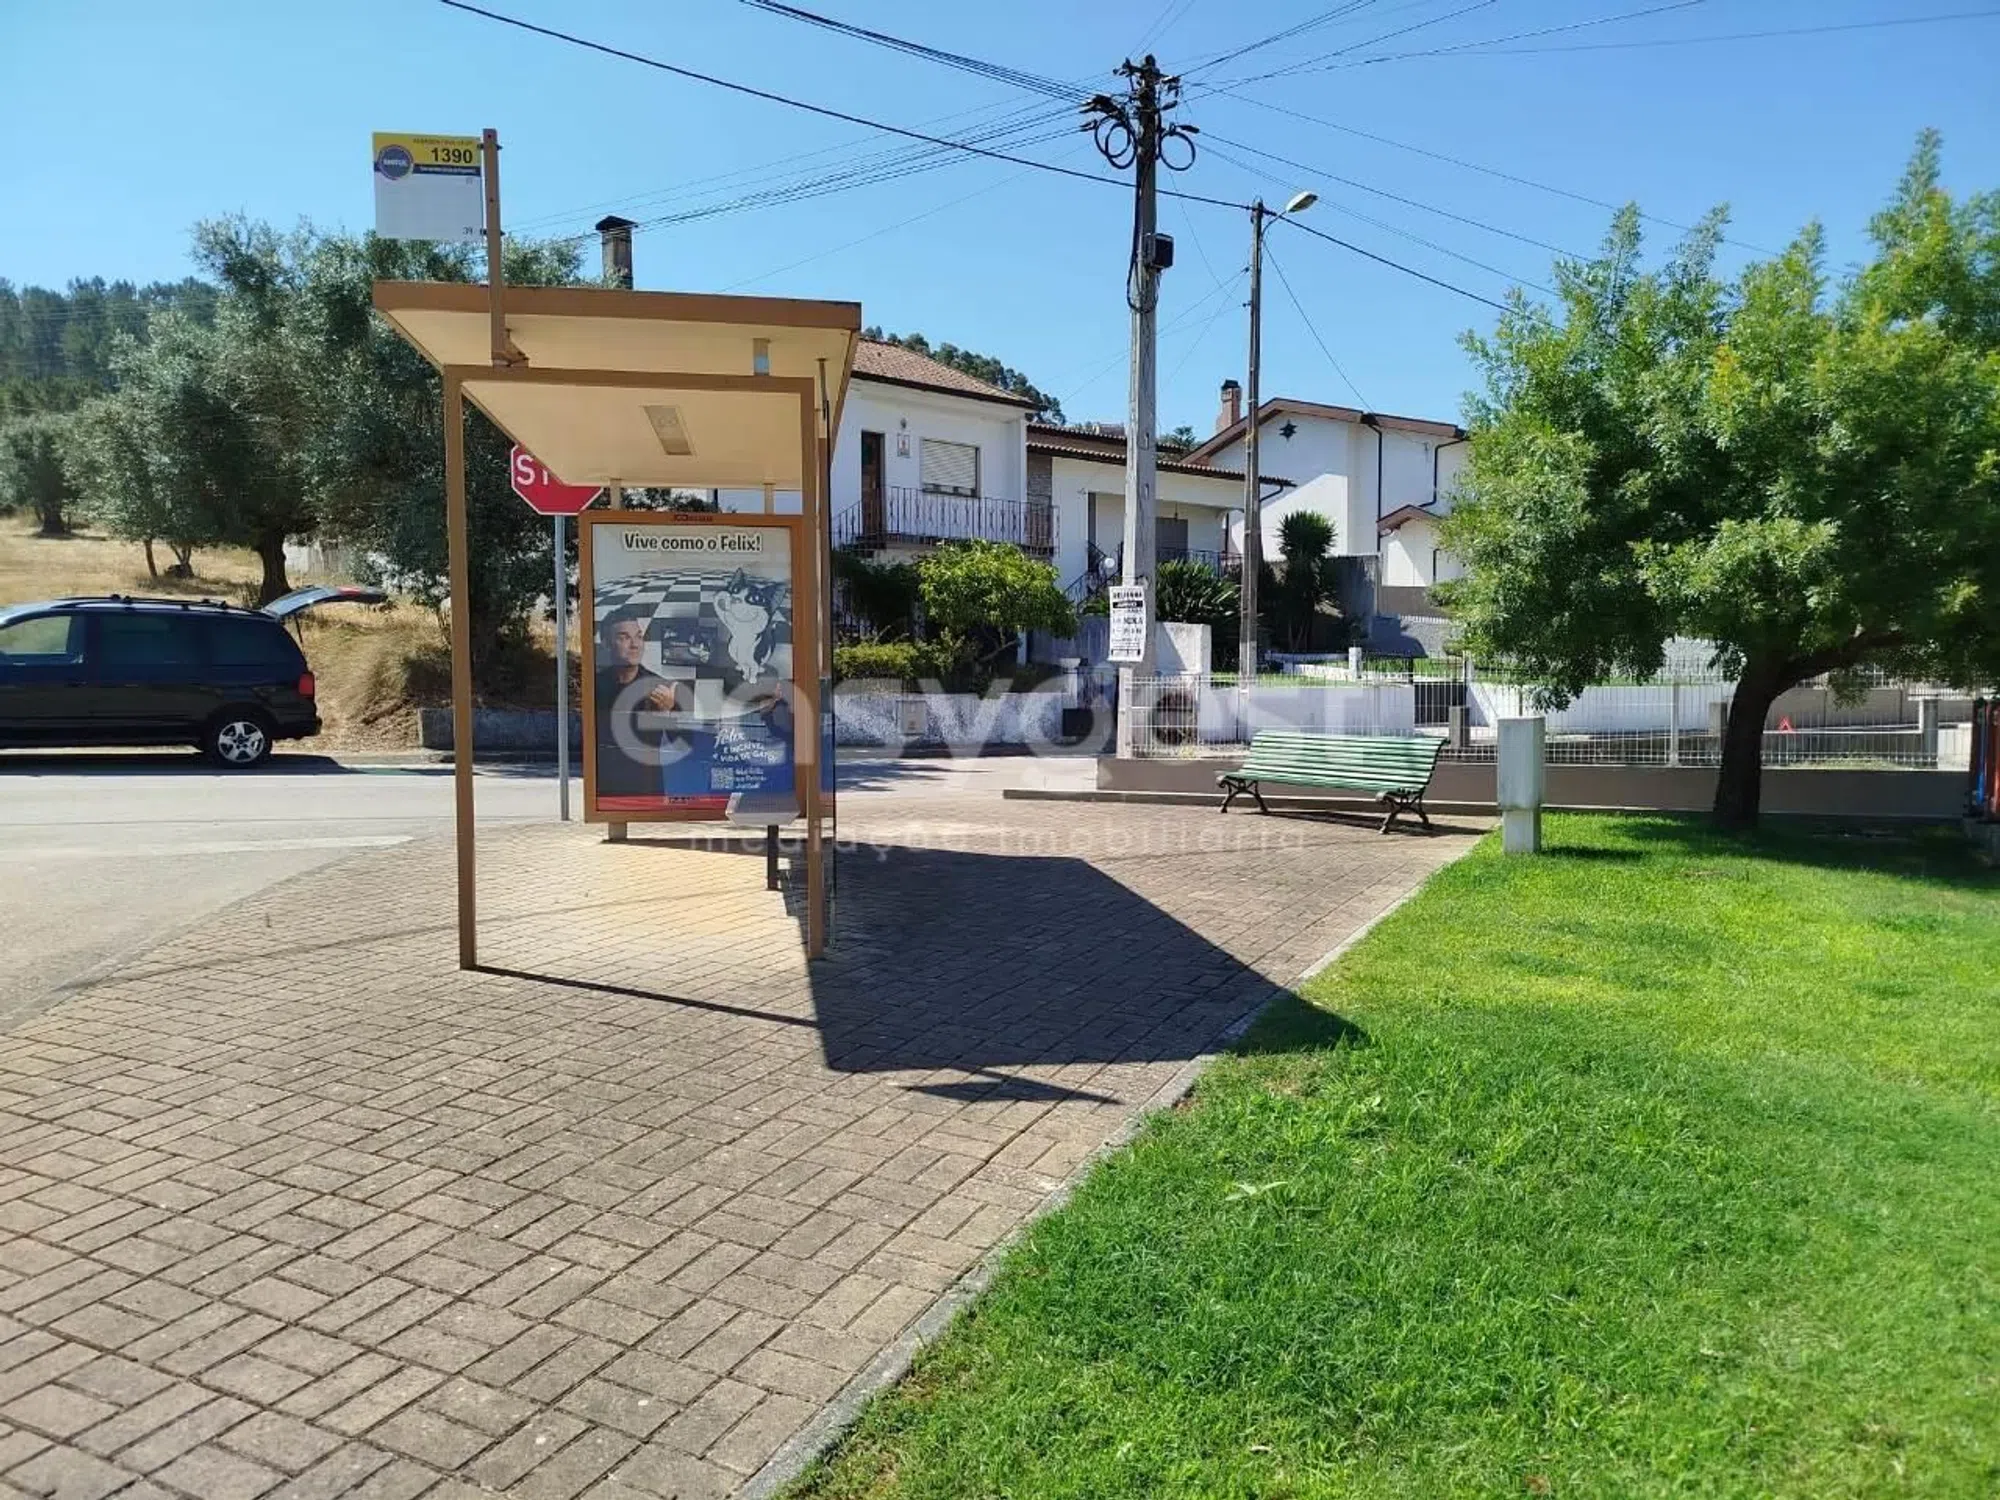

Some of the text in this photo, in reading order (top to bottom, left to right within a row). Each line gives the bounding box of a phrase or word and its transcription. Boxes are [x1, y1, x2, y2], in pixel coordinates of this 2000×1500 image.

[431, 147, 473, 164] 1390
[624, 532, 761, 551] Vive como o Felix!
